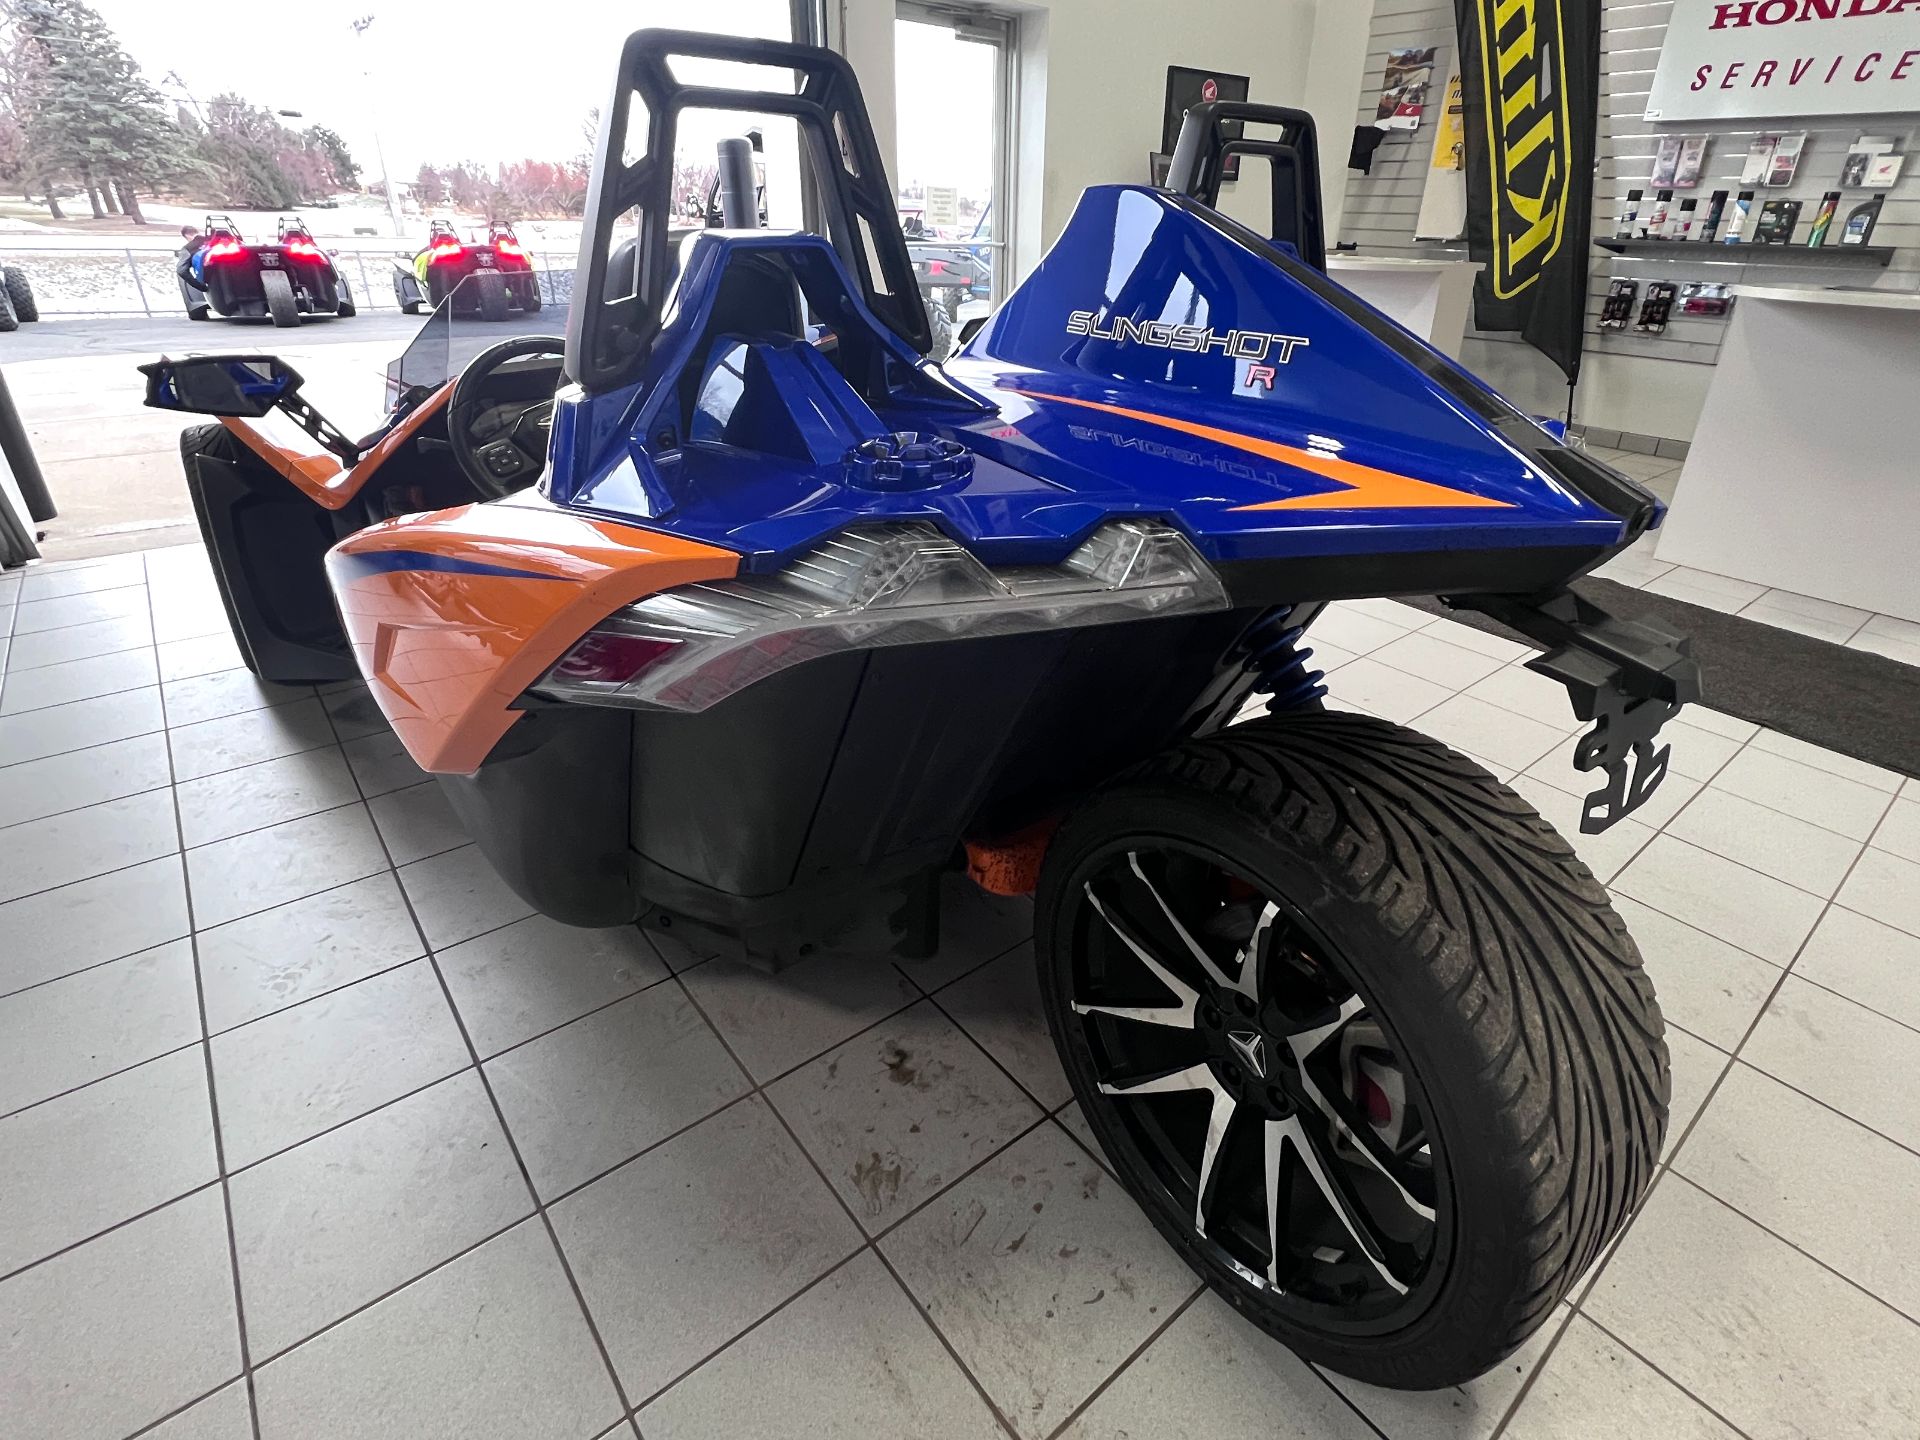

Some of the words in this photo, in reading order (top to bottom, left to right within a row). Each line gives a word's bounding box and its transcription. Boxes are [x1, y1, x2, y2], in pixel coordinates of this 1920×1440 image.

[1690, 50, 1920, 91] SERVICE
[1066, 310, 1310, 364] SLINGSHOT
[1244, 363, 1278, 390] R
